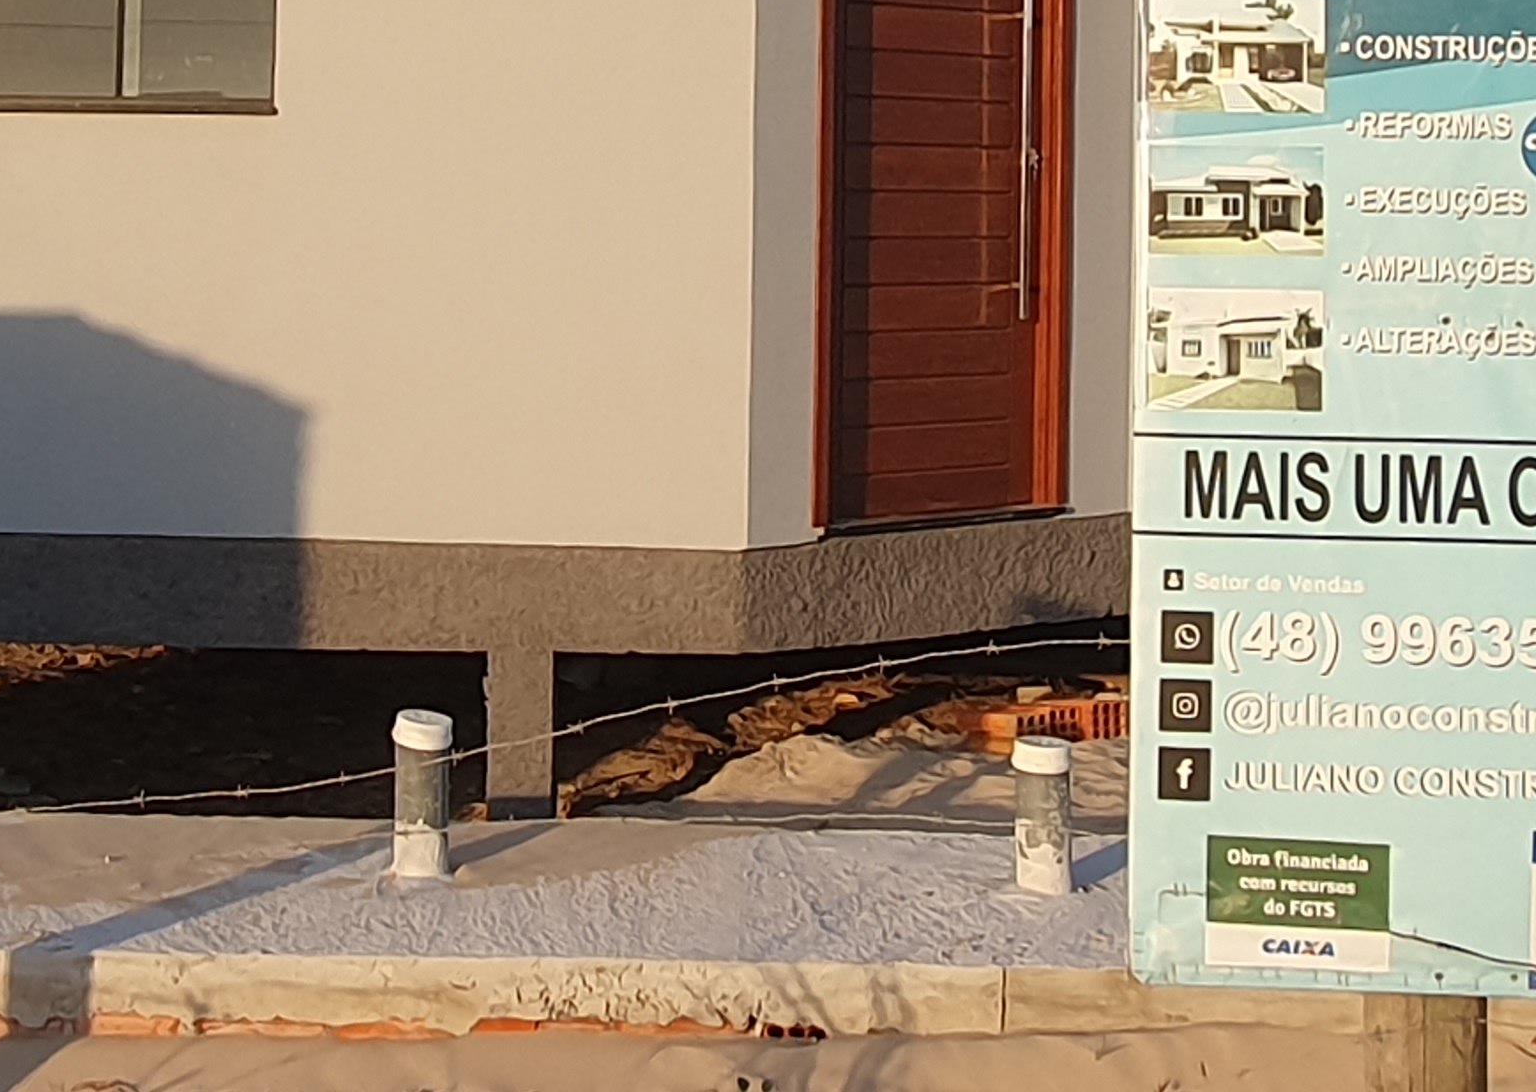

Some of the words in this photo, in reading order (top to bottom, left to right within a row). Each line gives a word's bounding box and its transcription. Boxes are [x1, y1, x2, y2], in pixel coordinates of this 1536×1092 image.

[1359, 113, 1513, 140] REFORMAS
[1359, 187, 1529, 221] EXECUÇÕES
[1355, 253, 1535, 289] AMPLIAÇÕES
[1183, 449, 1330, 522] MAIS
[1354, 453, 1490, 525] UMA
[1193, 571, 1251, 592] Setor
[1256, 574, 1282, 592] de
[1288, 574, 1365, 595] Vendas
[1220, 610, 1341, 675] (48)
[1224, 762, 1385, 796] JULIANO
[1227, 849, 1270, 869] Obra
[1274, 851, 1369, 873] financiada
[1239, 876, 1277, 892] com
[1281, 877, 1356, 896] recursos
[1264, 898, 1286, 916] do
[1289, 900, 1336, 919] FGTS
[1262, 938, 1336, 958] CAIXA
